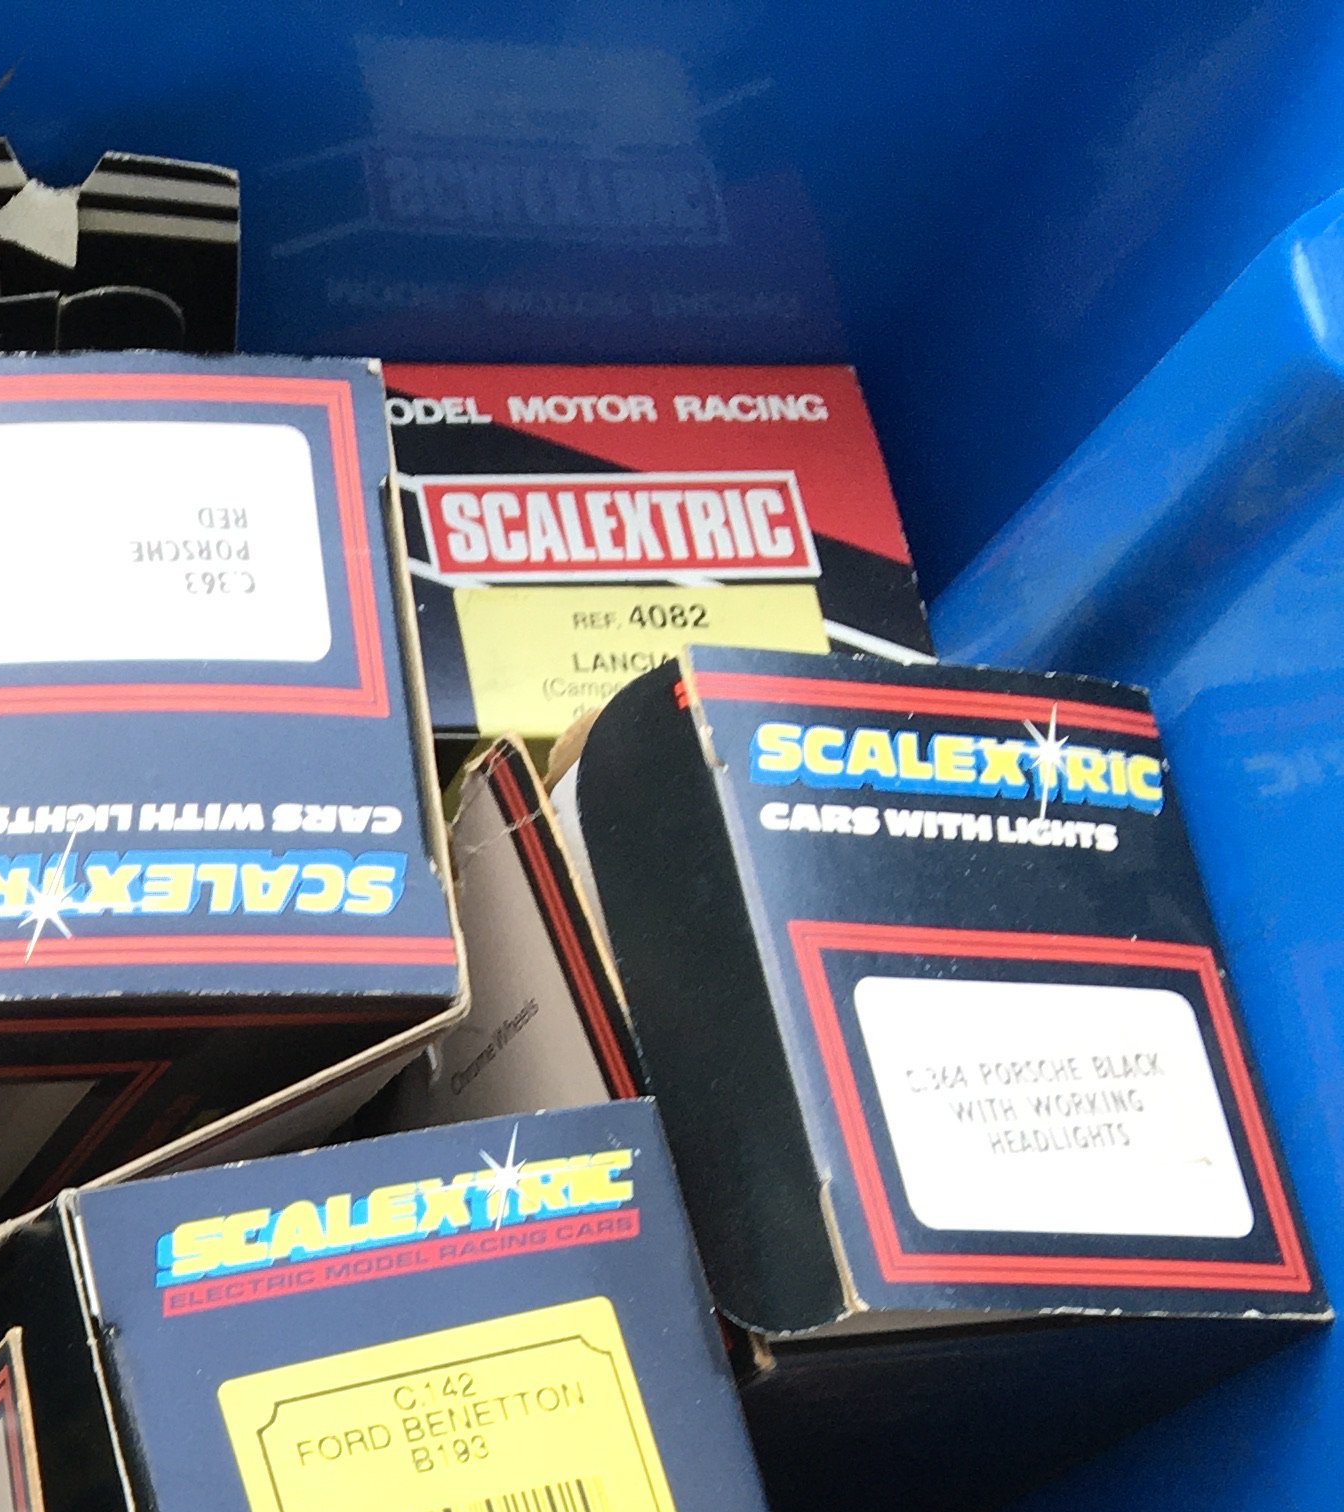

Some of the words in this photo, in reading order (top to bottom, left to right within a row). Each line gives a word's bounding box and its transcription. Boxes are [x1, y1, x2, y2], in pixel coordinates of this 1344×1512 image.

[508, 395, 658, 423] MOTOR
[674, 393, 828, 421] RACING
[198, 507, 248, 529] RED
[440, 488, 797, 564] SCALEXTRIC
[131, 540, 249, 562] PORSCHE
[186, 572, 255, 595] C.363
[628, 604, 711, 629] 4082
[748, 722, 1166, 815] SCALEXTRIC
[140, 804, 264, 831] WITH
[272, 806, 402, 833] CARS
[760, 802, 881, 836] CARS
[885, 811, 994, 843] WITH
[996, 818, 1119, 852] LIGHTS
[980, 1056, 1081, 1089] PORSCHE
[1092, 1053, 1166, 1080] BLACK
[949, 1097, 1016, 1124] WITH
[1029, 1089, 1144, 1119] WORKING
[987, 1125, 1132, 1156] HEADLIGHTS
[156, 1149, 636, 1287] SCALEXTRIC
[167, 1270, 319, 1312] ELECTRIC
[324, 1248, 431, 1282] MODEL
[438, 1227, 548, 1263] RACING
[554, 1215, 636, 1241] CARS
[393, 1373, 478, 1410] C.142
[296, 1423, 393, 1466] FORD
[402, 1381, 586, 1444] BENETTON
[411, 1436, 491, 1474] B193
